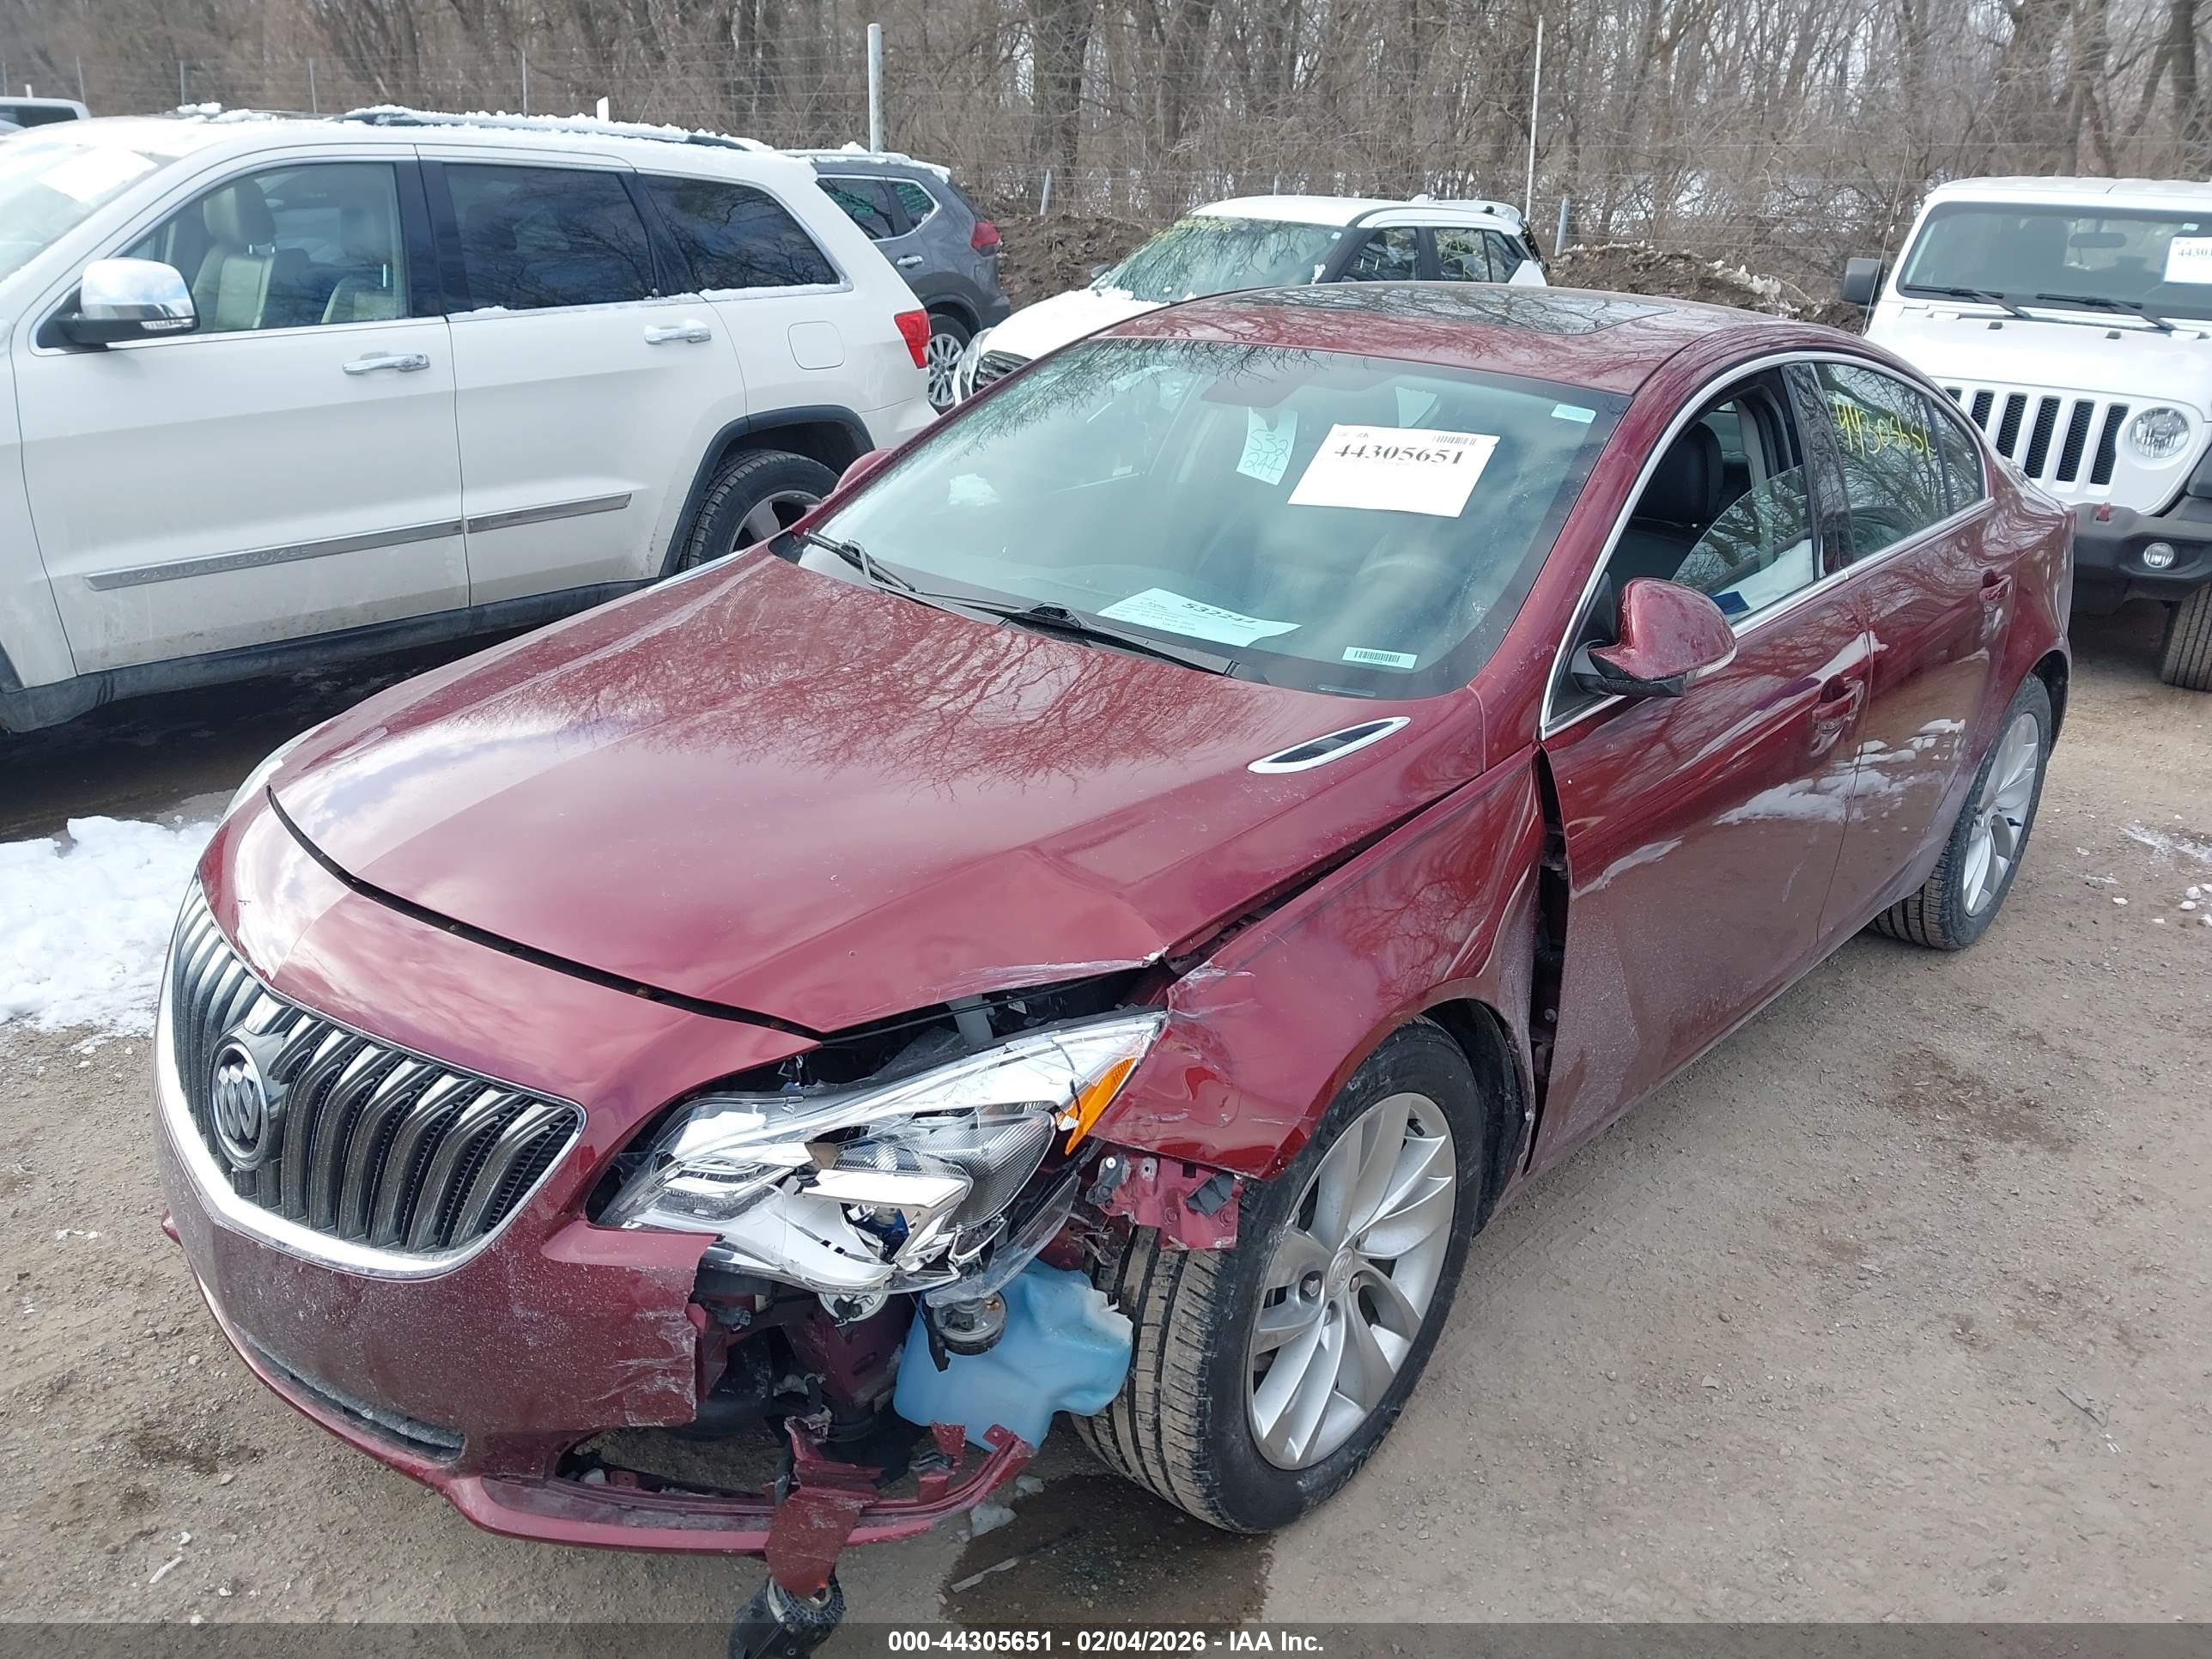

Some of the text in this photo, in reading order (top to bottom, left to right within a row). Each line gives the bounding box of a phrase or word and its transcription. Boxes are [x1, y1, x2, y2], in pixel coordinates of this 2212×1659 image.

[2177, 247, 2212, 258] 4430
[1834, 398, 1933, 463] 44305651
[1243, 452, 1283, 477] 244
[1334, 444, 1465, 465] 44305651
[120, 548, 310, 583] GRAND CHEROKEE
[1181, 601, 1257, 624] 532244
